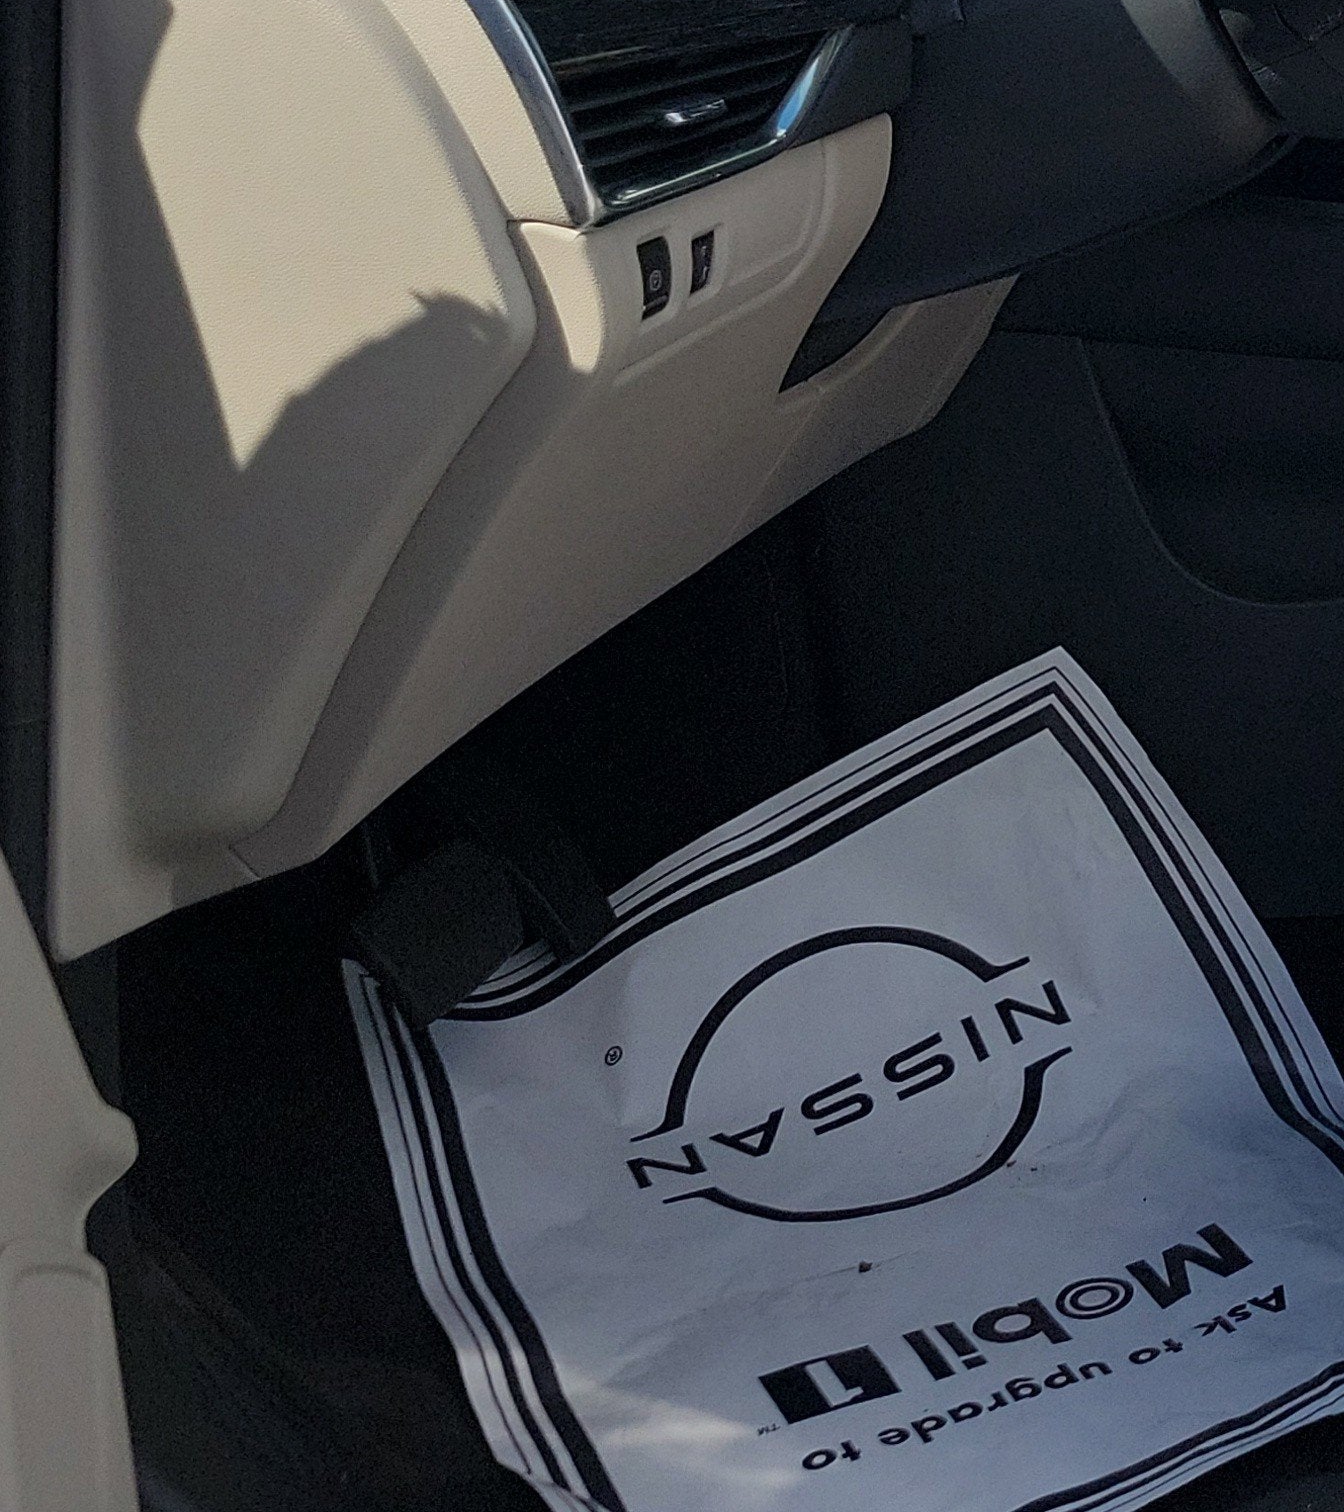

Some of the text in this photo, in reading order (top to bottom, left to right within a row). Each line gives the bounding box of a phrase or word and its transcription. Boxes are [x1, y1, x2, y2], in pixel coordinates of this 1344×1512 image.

[625, 979, 1072, 1189] NISSAN
[801, 1284, 1288, 1471] Ask to upgrade to
[902, 1223, 1253, 1381] Mobil
